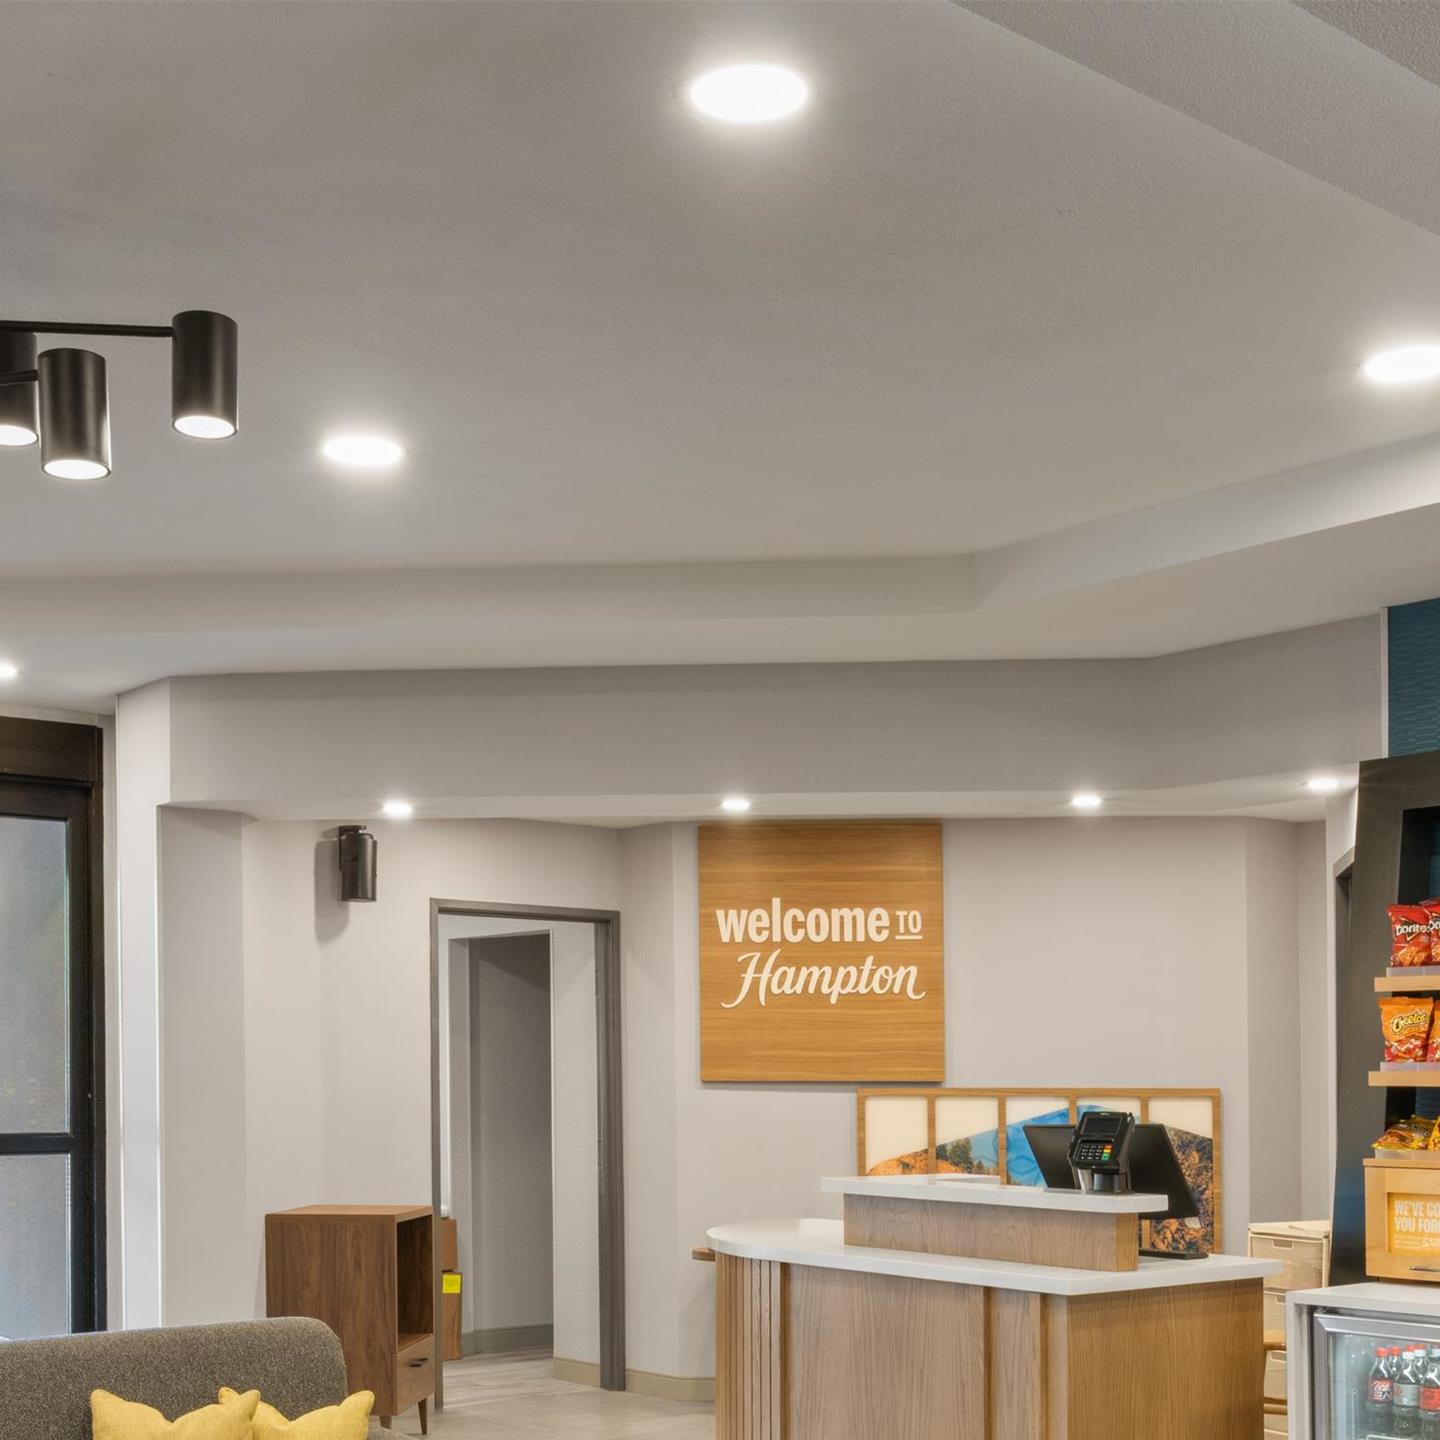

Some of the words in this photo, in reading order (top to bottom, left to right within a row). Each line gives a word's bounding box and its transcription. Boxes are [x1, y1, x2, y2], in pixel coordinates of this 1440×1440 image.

[716, 898, 890, 943] welcome
[895, 910, 922, 934] TO
[720, 949, 926, 1009] Hampton
[1394, 1216, 1415, 1232] YOU
